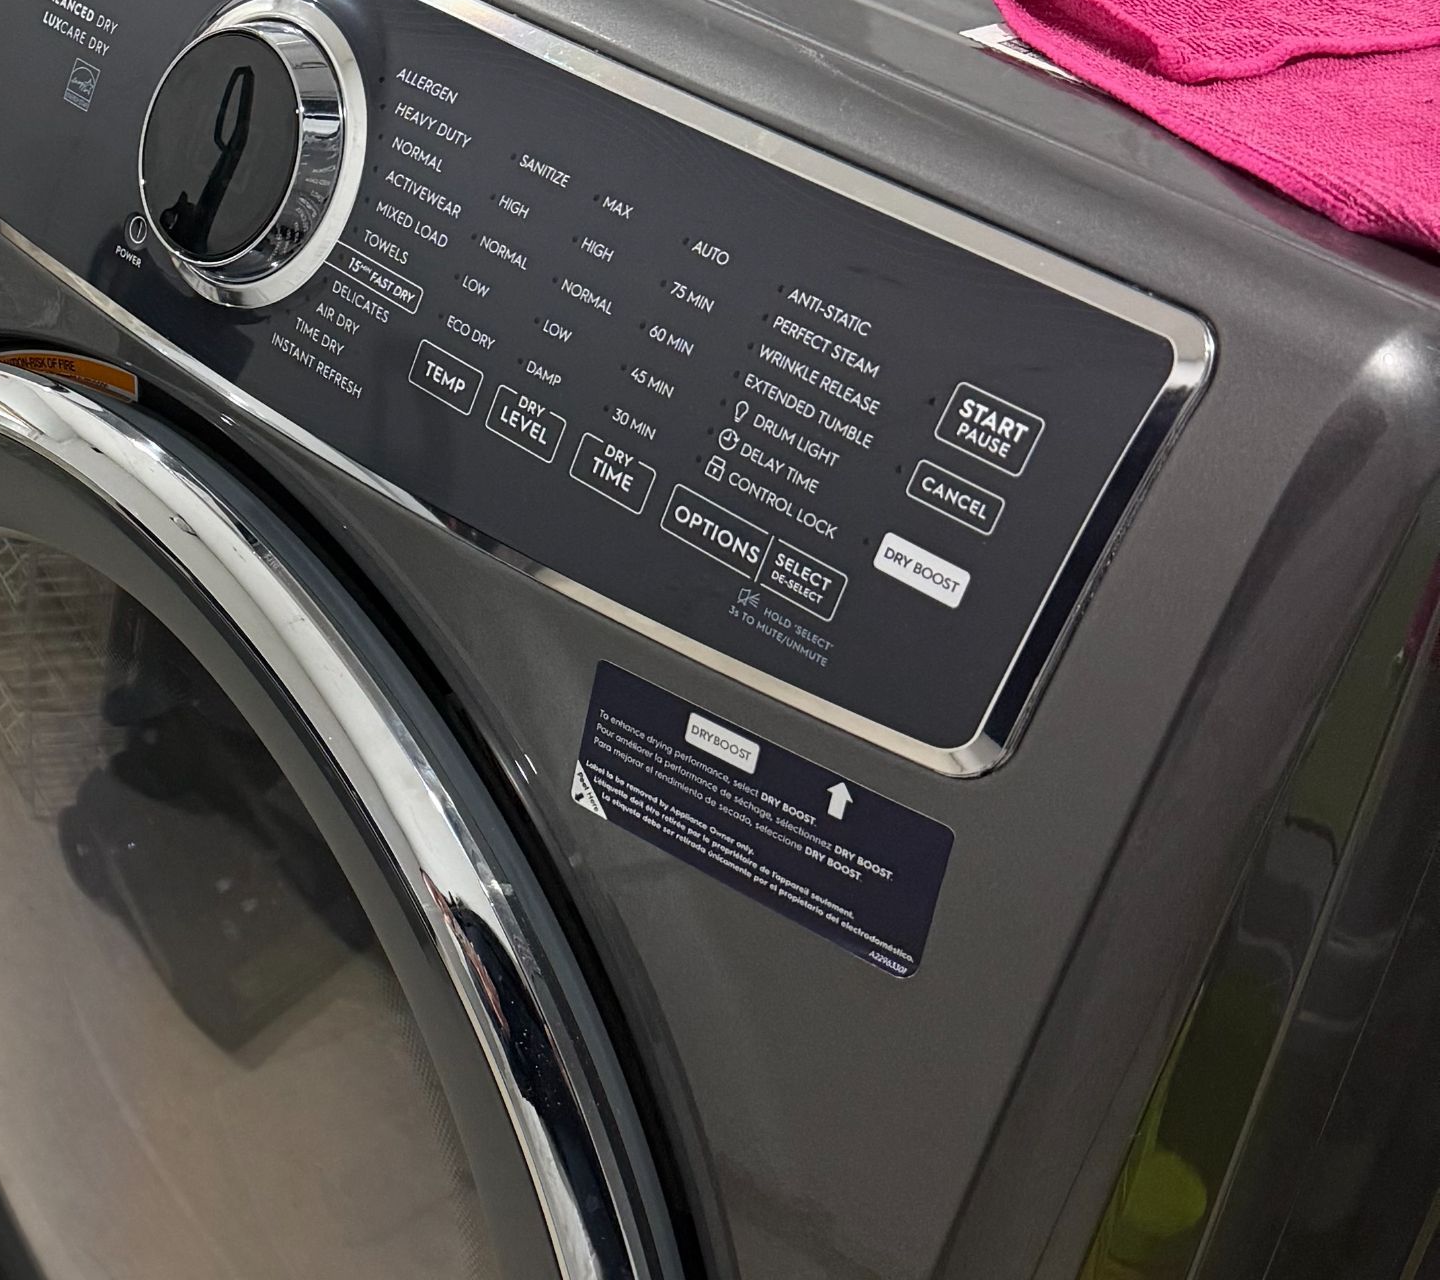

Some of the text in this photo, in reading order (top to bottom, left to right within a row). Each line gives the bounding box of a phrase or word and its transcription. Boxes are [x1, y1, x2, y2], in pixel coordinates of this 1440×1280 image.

[42, 11, 110, 57] LUXCARE DRY
[96, 15, 118, 35] DRY
[396, 68, 458, 104] ALLERGEN
[395, 102, 472, 148] HEAVY DUTY
[392, 137, 442, 173] NORMAL
[519, 154, 571, 188] SANITIZE
[385, 170, 461, 219] ACTIVEWEAR
[499, 195, 530, 219] HIGH
[602, 196, 634, 220] MAX
[376, 201, 448, 248] MIXED LOAD
[115, 246, 141, 268] POWER
[365, 229, 409, 265] TOWELS
[480, 235, 528, 270] NORMAL
[581, 237, 614, 263] HIGH
[691, 240, 730, 266] AUTO
[332, 280, 389, 323] DELICATES
[370, 272, 394, 291] FAST
[393, 285, 415, 303] DRY
[462, 275, 490, 298] LOW
[561, 279, 613, 315] NORMAL
[670, 281, 715, 313] 75 MIN
[316, 302, 360, 336] AIR DRY
[787, 288, 872, 336] ANTI-STATIC
[296, 317, 345, 356] TIME DRY
[447, 315, 496, 350] ECO DRY
[543, 319, 573, 343] LOW
[649, 325, 695, 357] 60 MIN
[773, 315, 880, 379] PERFECT STEAM
[58, 359, 76, 373] FIRE
[272, 332, 362, 399] INSTANT REFRESH
[425, 360, 466, 394] TEMP
[526, 360, 562, 387] DAMP
[630, 368, 675, 399] 45 MIN
[760, 344, 881, 416] WRINKLE RELEASE
[500, 405, 547, 445] LEVEL
[518, 396, 546, 418] DRY
[612, 408, 657, 441] 30 MIN
[744, 373, 874, 450] EXTENDED TUMBLE
[959, 399, 1029, 444] START
[604, 444, 634, 467] DRY
[753, 414, 840, 467] DRUM LIGHT
[956, 422, 1011, 458] PAUSE
[591, 457, 634, 493] TIME
[740, 443, 821, 494] DELAY TIME
[728, 471, 839, 540] CONTROL LOCK
[921, 476, 987, 520] CANCEL
[674, 505, 760, 564] OPTIONS
[770, 570, 824, 605] DE-SELECT
[775, 552, 832, 591] SELECT
[884, 546, 960, 593] DRY BOOST
[764, 608, 792, 629] HOLD
[742, 612, 755, 625] TO
[756, 621, 829, 667] MUTE/UNMUTE
[600, 709, 817, 827] To enhance drying performance, select DRY BOOST.
[586, 760, 755, 856] Label to be removed by Appliance Owner only.
[593, 736, 863, 882] Para mejorar el rendimiento de secado, seleccione DRY BOOST.
[596, 722, 893, 881] Pour améliorer la performance de séchage, sélectionnez DRY BOOST.
[601, 792, 611, 802] La
[642, 814, 662, 829] debe
[662, 826, 675, 837] ser
[676, 833, 706, 853] retirada
[753, 875, 769, 886] por
[769, 883, 778, 892] el
[778, 888, 824, 916] propietario
[825, 912, 840, 924] del
[687, 827, 701, 839] par
[759, 865, 771, 875] de
